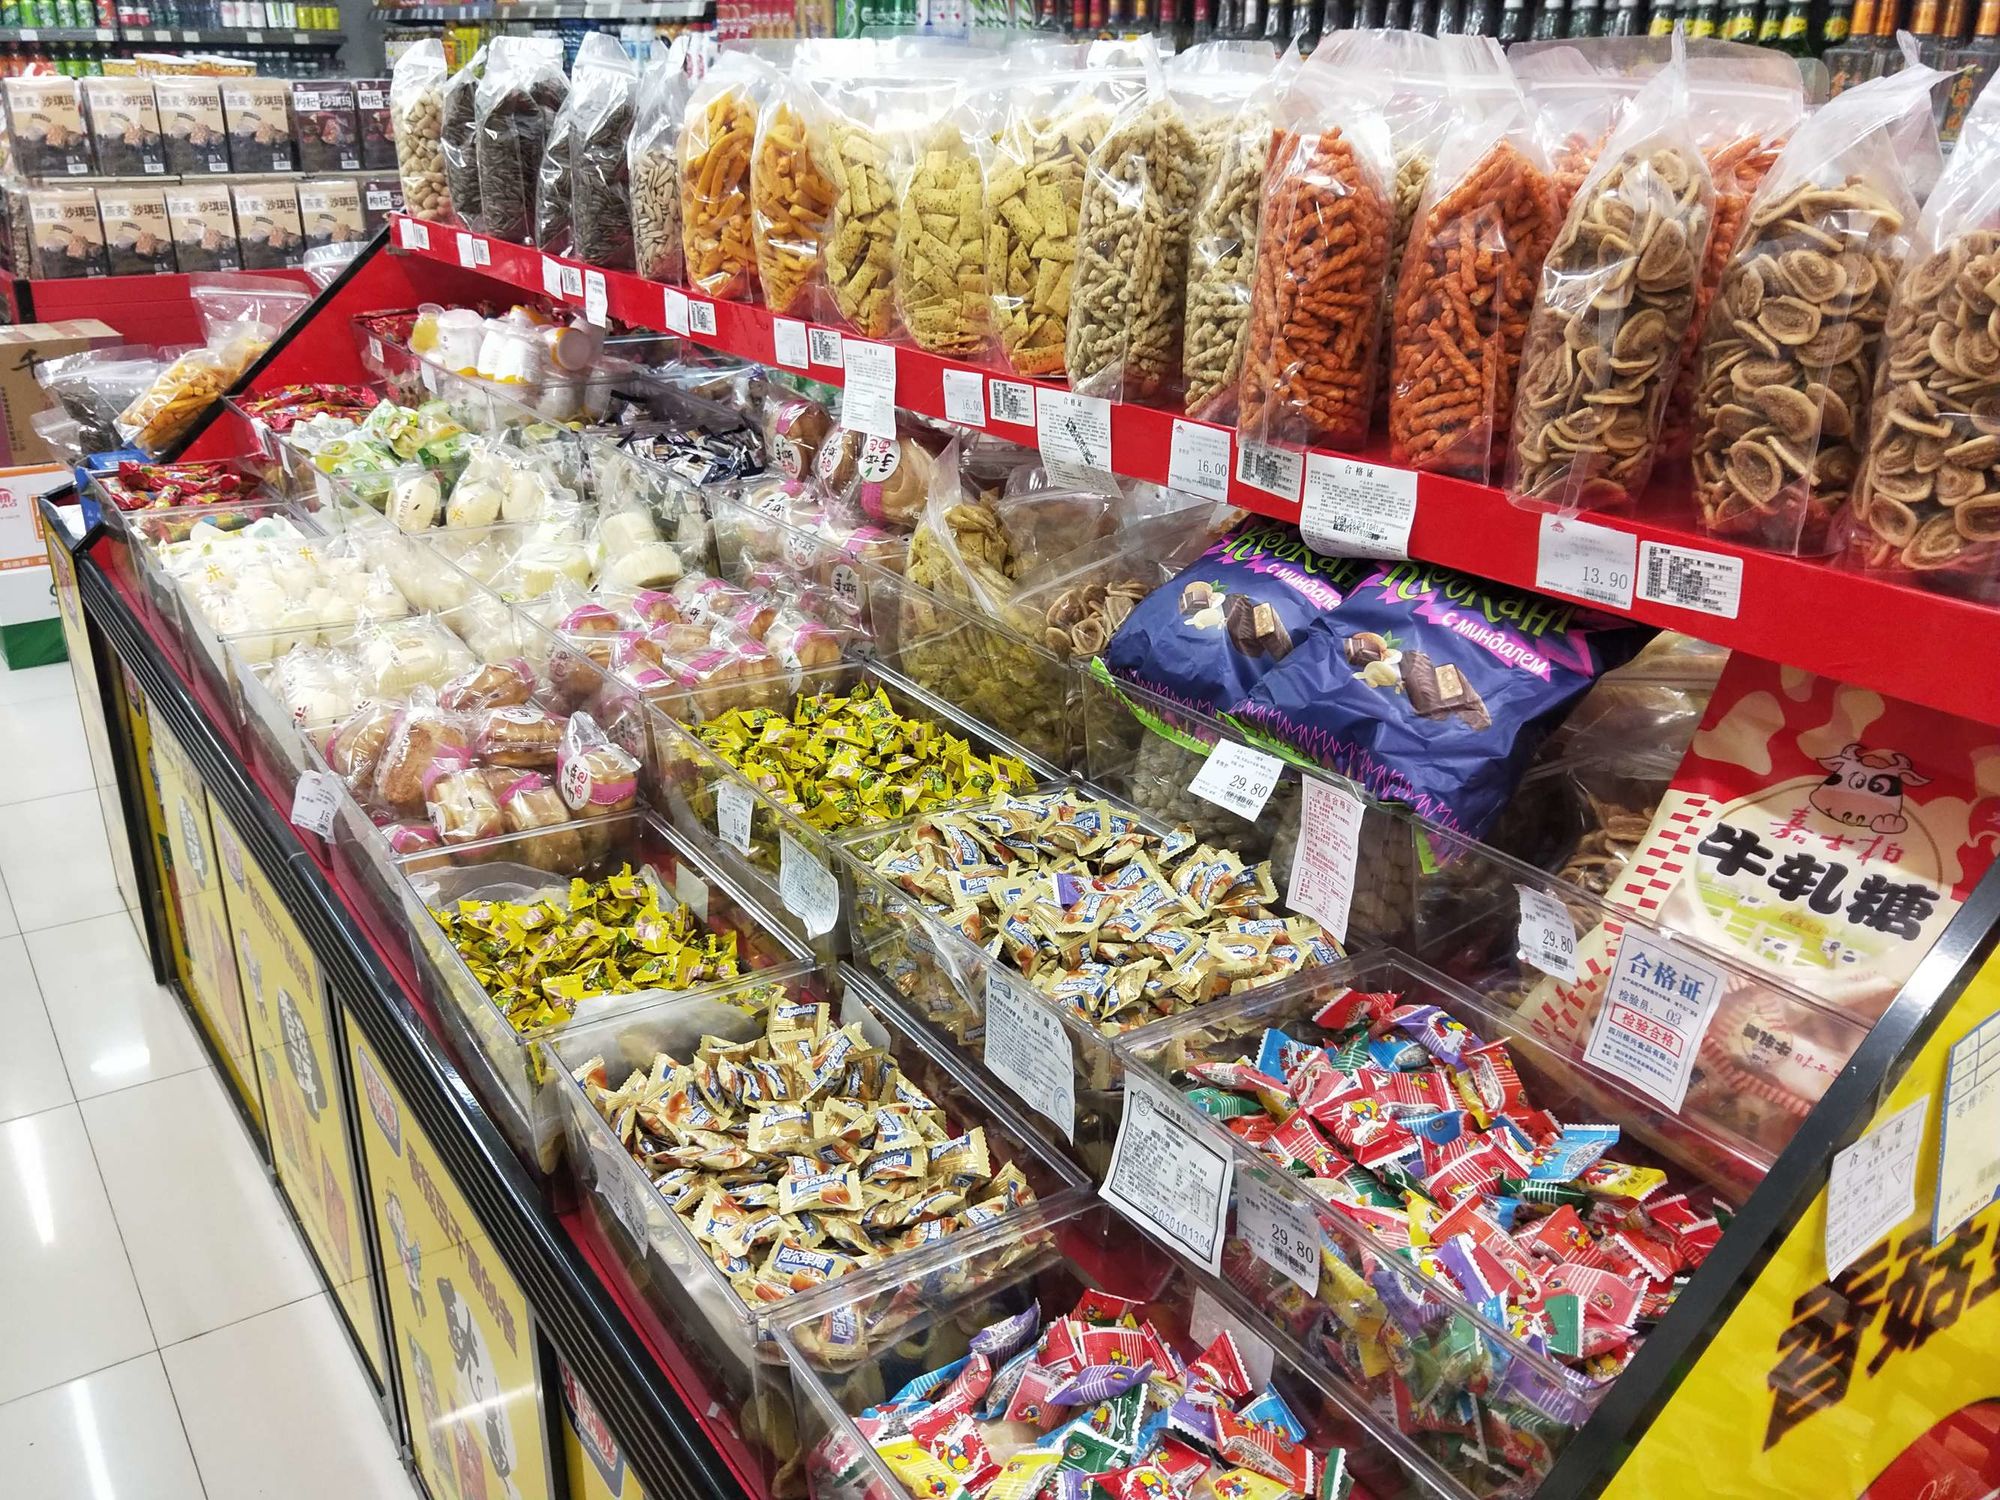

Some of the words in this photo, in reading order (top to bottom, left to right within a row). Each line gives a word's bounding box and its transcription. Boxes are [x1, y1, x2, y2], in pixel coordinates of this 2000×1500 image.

[1198, 459, 1228, 477] 16.00
[1344, 464, 1375, 479] 合格证
[1273, 568, 1342, 611] миндале
[1582, 566, 1628, 590] 13.90
[1453, 617, 1549, 677] миндалем
[1229, 774, 1268, 798] 29.80
[1697, 820, 1941, 941] 牛轧糖
[1543, 928, 1573, 955] 29.80
[1629, 951, 1705, 1006] 合格证
[1622, 1011, 1674, 1048] 检验合格
[1666, 1008, 1683, 1026] 03
[1271, 1223, 1315, 1265] 29.80
[779, 1247, 830, 1270] 阿尔卑斯
